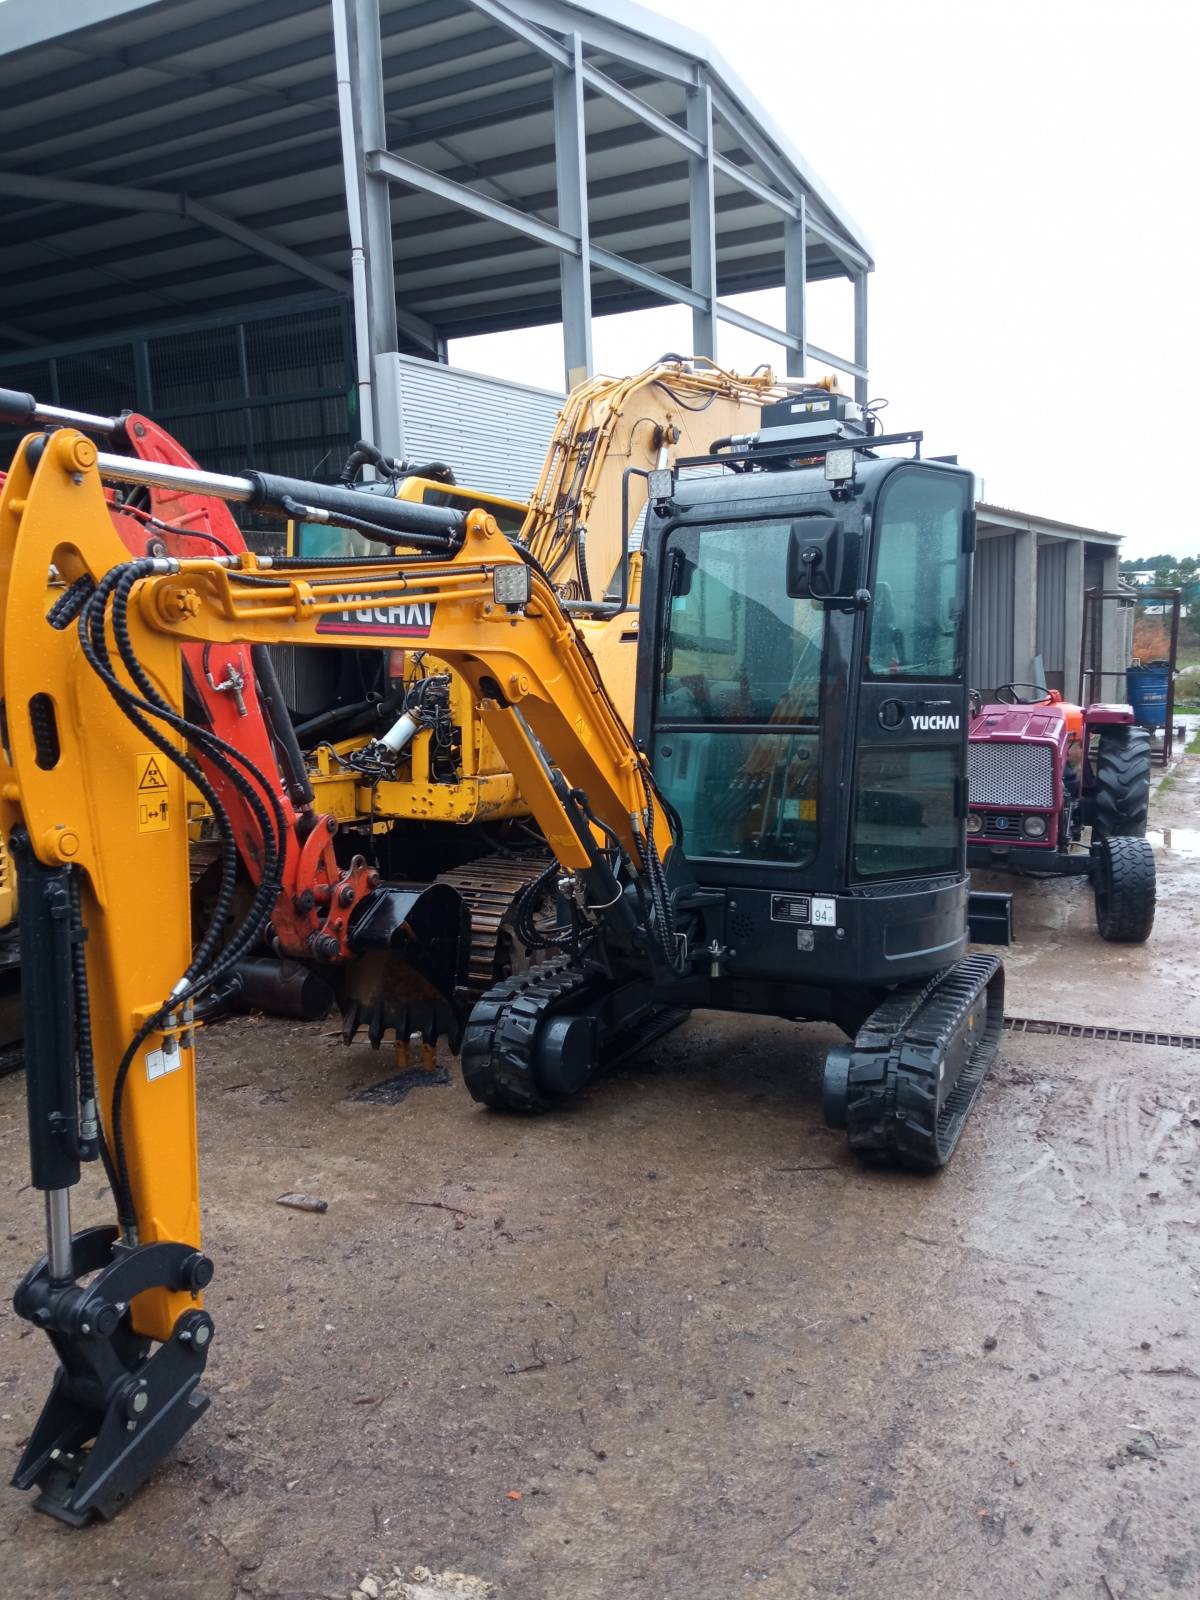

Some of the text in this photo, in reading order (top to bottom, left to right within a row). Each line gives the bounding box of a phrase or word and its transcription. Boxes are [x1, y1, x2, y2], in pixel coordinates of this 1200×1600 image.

[336, 593, 431, 626] YUCHAI
[910, 715, 960, 730] YUCHAI
[815, 910, 827, 921] 94
